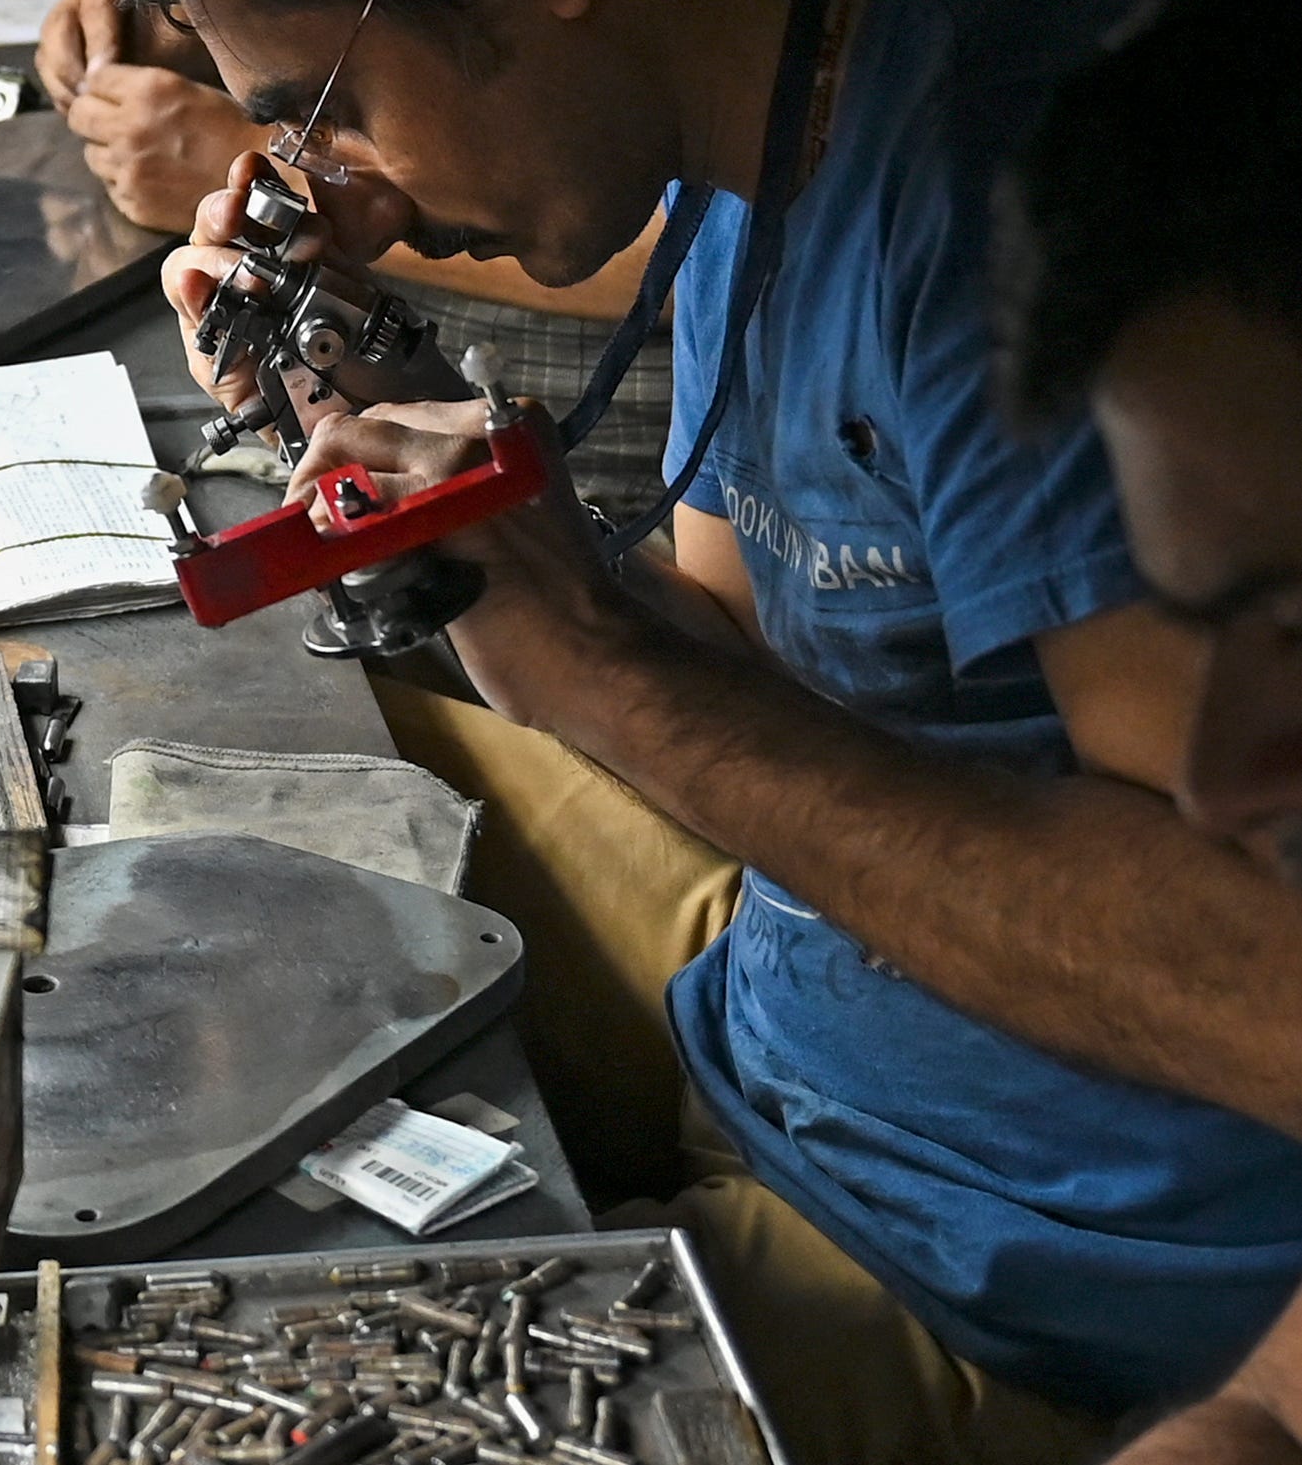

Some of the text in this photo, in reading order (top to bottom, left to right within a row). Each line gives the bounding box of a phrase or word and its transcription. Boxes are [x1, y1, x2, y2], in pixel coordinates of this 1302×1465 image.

[725, 485, 921, 590] OOKLYN BAN
[745, 897, 806, 990] ORK
